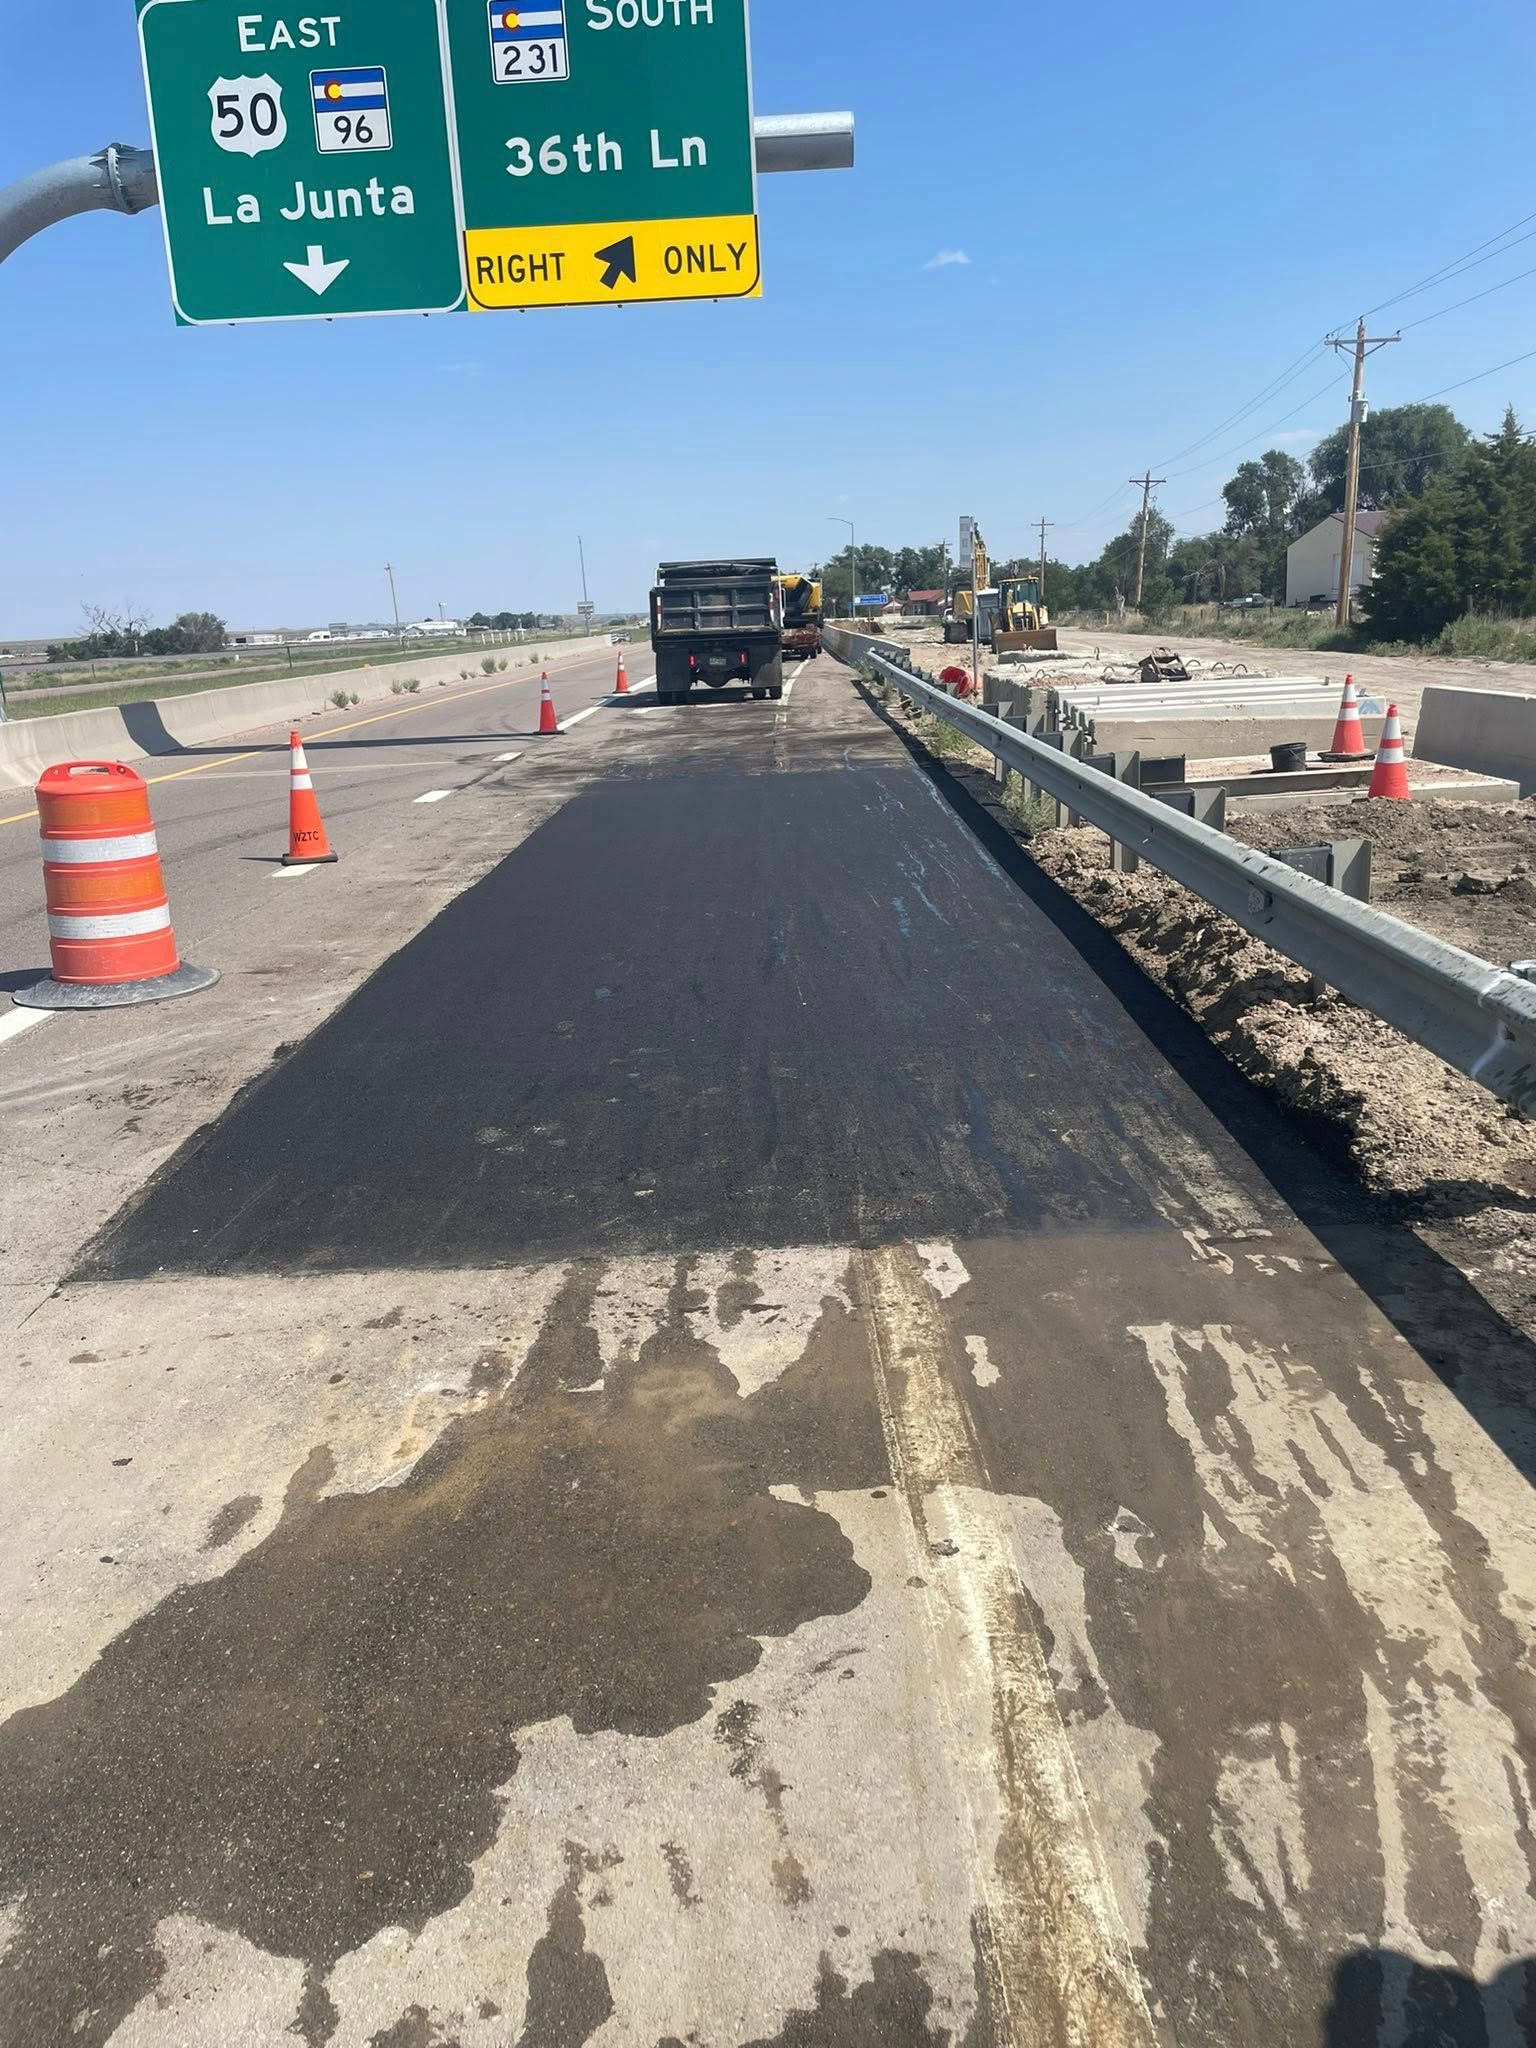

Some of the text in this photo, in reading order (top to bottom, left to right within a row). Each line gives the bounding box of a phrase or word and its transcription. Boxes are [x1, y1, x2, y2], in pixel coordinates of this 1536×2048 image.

[237, 15, 341, 52] EAST
[586, 0, 714, 31] SOUTH
[502, 43, 558, 76] 231
[216, 92, 278, 138] 50
[333, 115, 373, 144] 96
[504, 129, 707, 177] 36th Ln
[202, 177, 415, 225] La Junta
[475, 242, 747, 285] RIGHT ONLY
